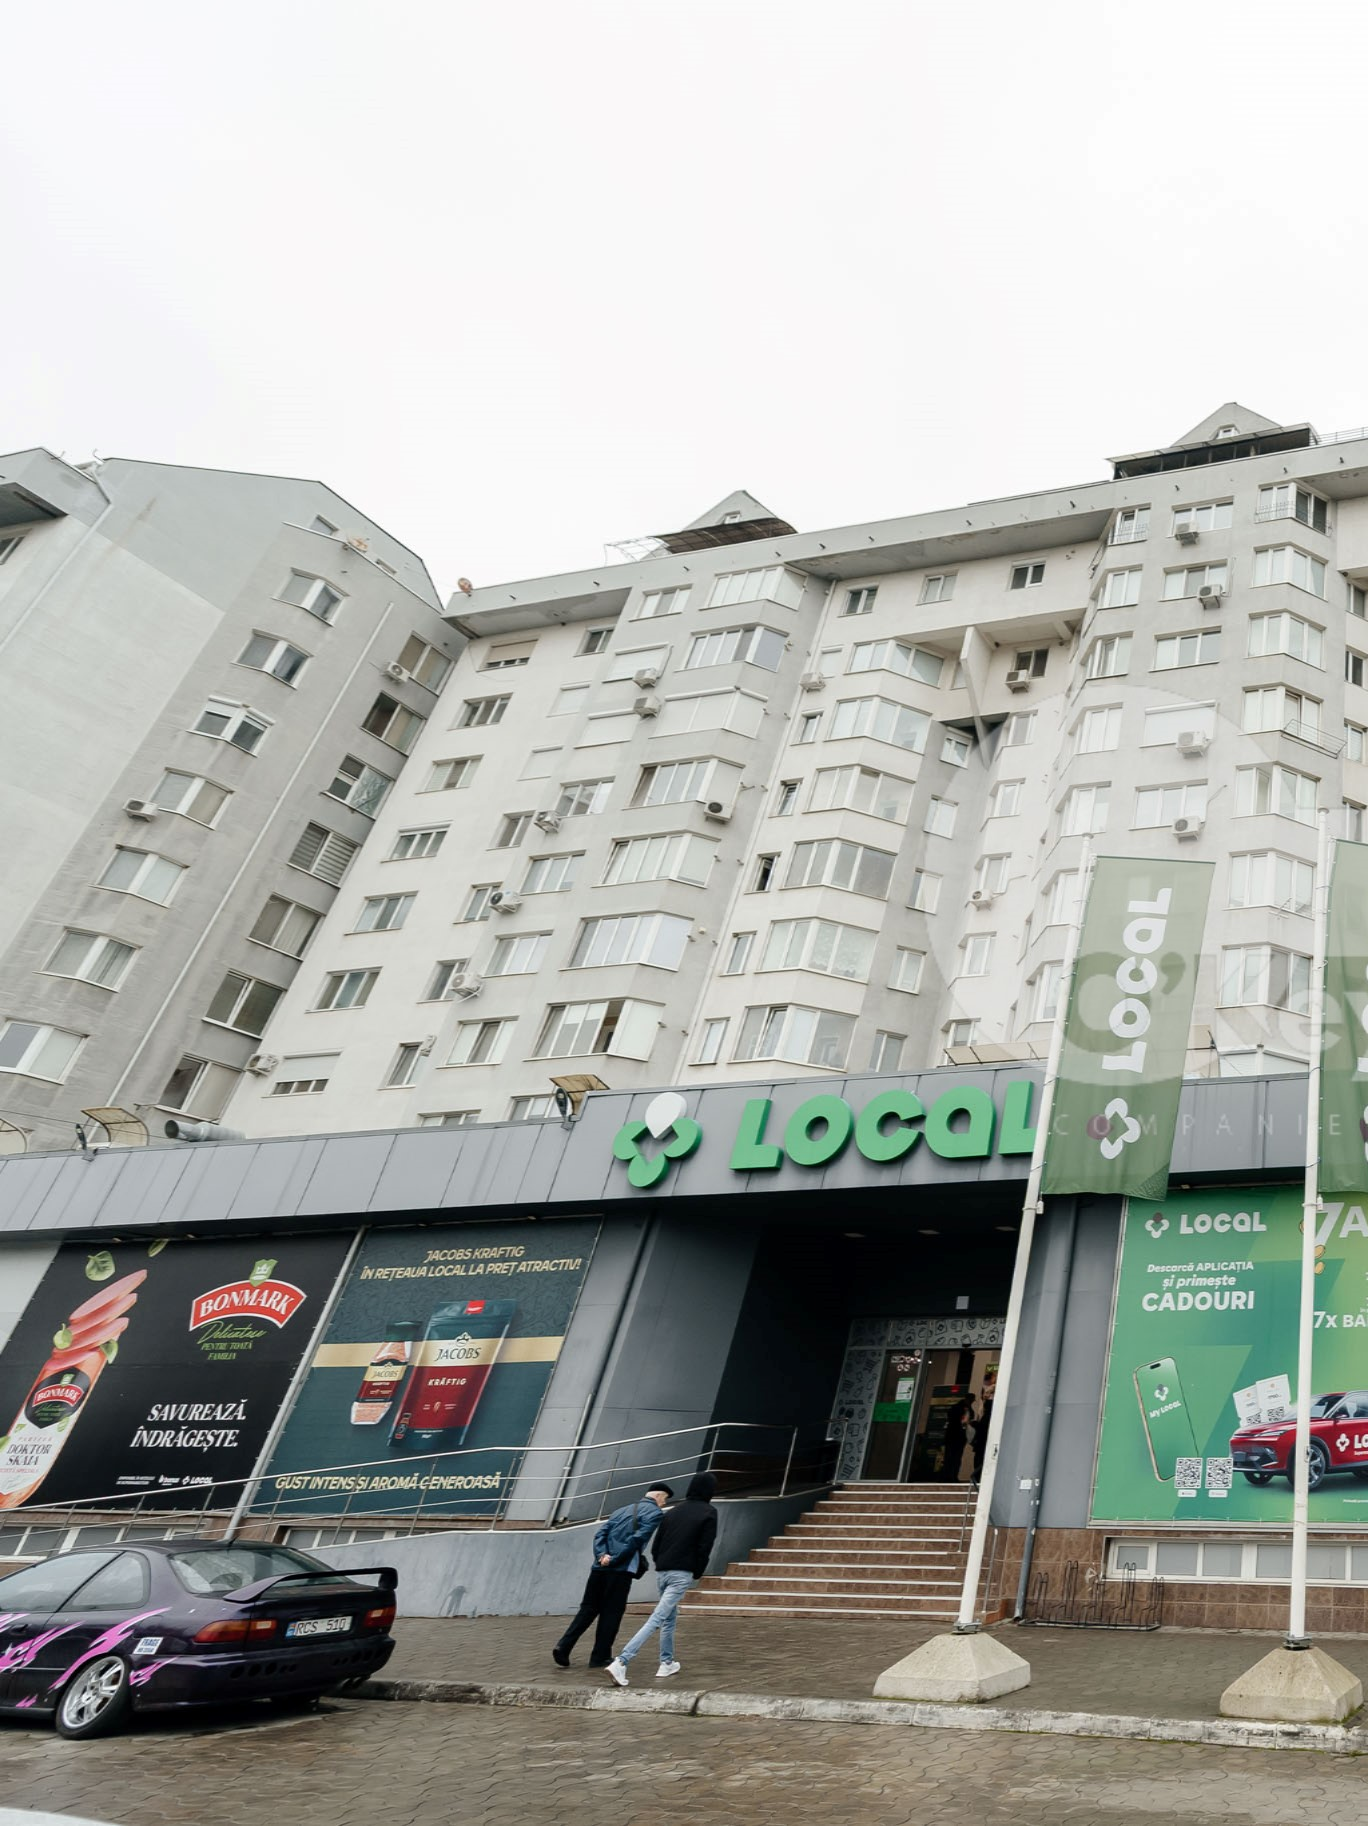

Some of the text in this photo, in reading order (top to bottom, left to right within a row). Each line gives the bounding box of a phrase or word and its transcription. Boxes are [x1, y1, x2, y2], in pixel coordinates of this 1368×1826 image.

[1101, 887, 1172, 1073] LOCAL
[729, 1080, 1036, 1170] LOCAL
[1179, 1211, 1267, 1235] LOCAL
[423, 1250, 472, 1263] JACOBS
[1147, 1261, 1255, 1273] Descarcă APLICAȚIA
[360, 1266, 374, 1280] ÎN
[428, 1264, 467, 1276] LOCAL
[468, 1263, 485, 1275] LA
[485, 1262, 517, 1276] PREȚ
[517, 1258, 582, 1272] ATRACTIV!
[1176, 1273, 1238, 1290] primește
[200, 1289, 295, 1318] BONMARK
[1141, 1290, 1256, 1312] CADOURI
[1313, 1311, 1338, 1329] 7x
[434, 1347, 482, 1361] JACOBS
[147, 1399, 248, 1421] SAVUREAZĂ.
[129, 1425, 240, 1453] ÎNDRĂGEȘTE.
[275, 1476, 309, 1490] GUST
[309, 1476, 356, 1490] INTENS
[369, 1473, 419, 1490] AROMĂ
[295, 1618, 346, 1634] RCS 510
